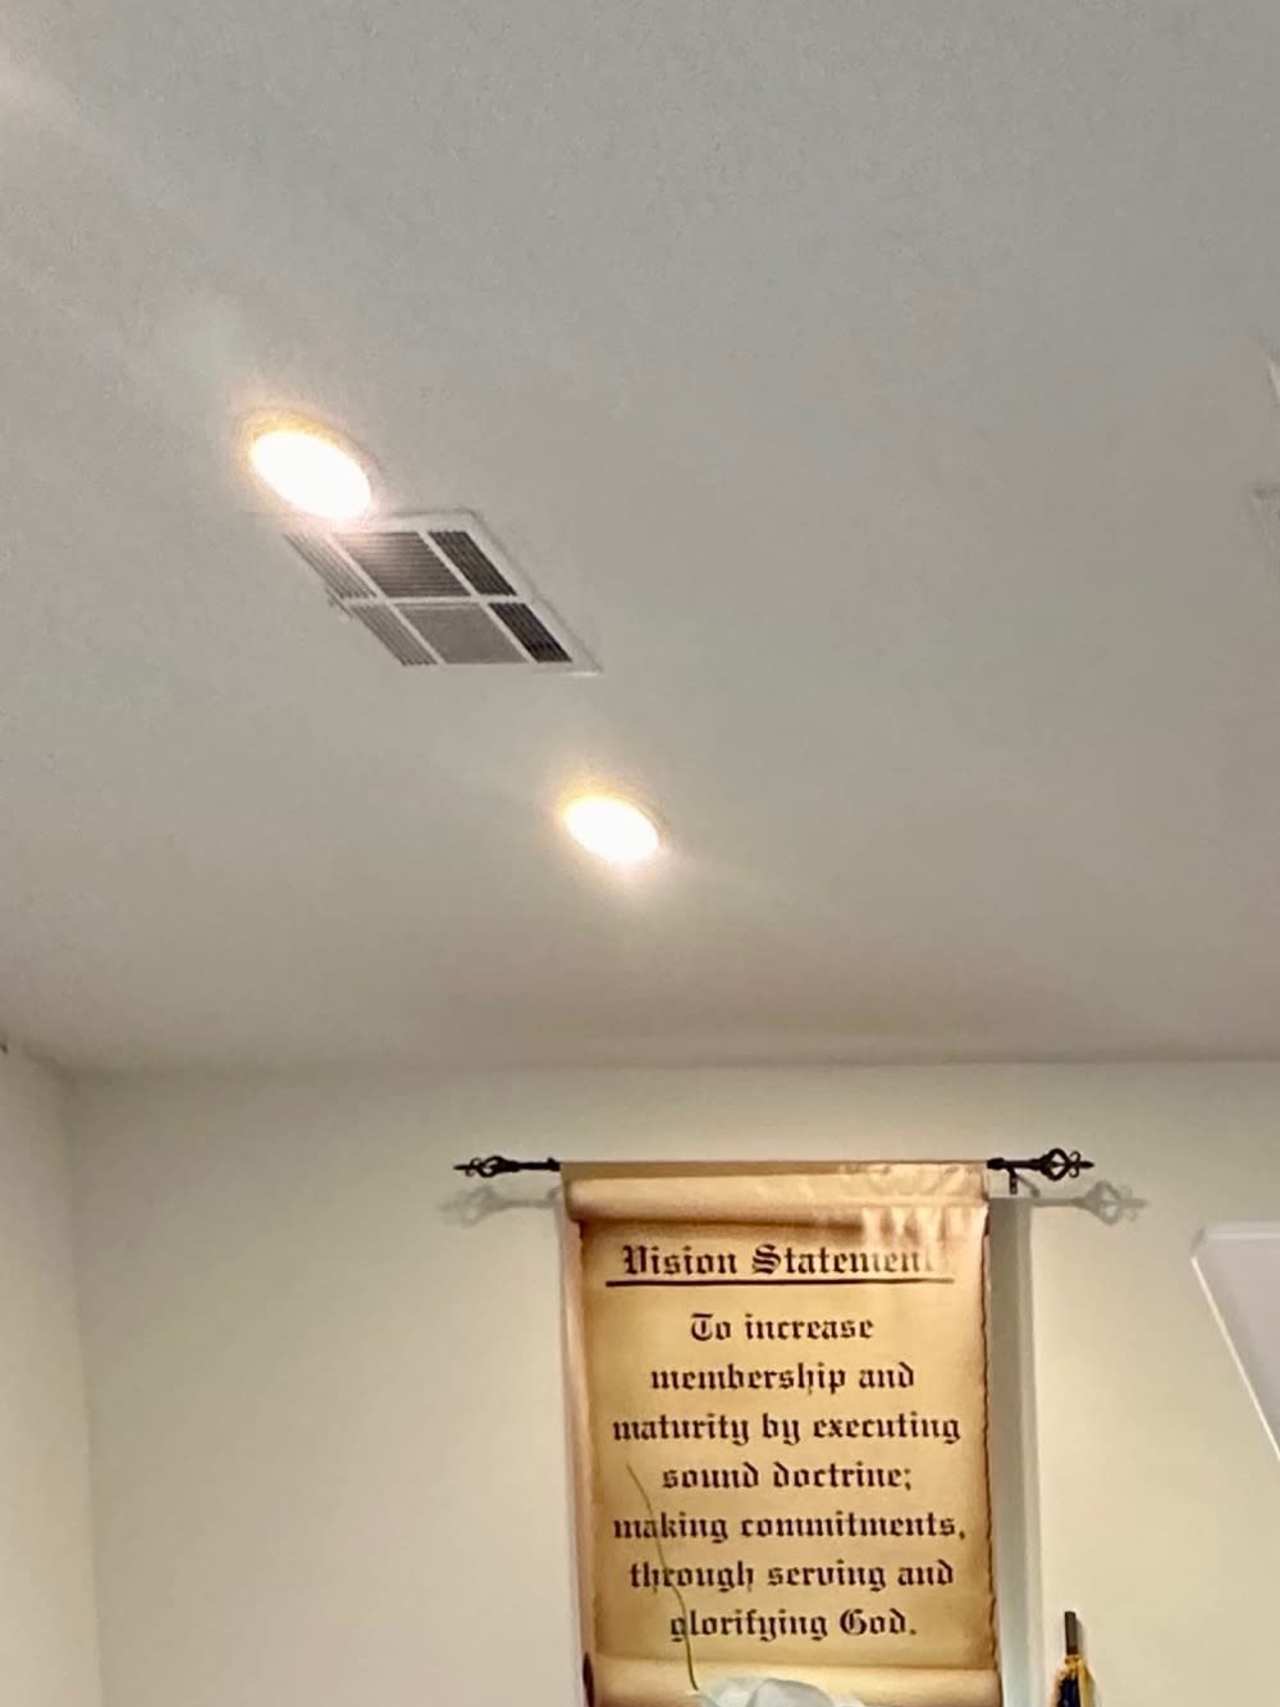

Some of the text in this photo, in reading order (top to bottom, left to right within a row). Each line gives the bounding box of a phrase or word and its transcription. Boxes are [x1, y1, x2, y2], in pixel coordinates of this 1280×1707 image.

[622, 1244, 737, 1275] Vision
[690, 1312, 874, 1341] To increase
[650, 1361, 915, 1396] membership and
[612, 1411, 962, 1446] maturity by executing
[662, 1461, 912, 1491] sound doctrine;
[612, 1510, 966, 1543] making commitments,
[630, 1559, 954, 1594] through serving and
[669, 1608, 917, 1642] glorifying God.
